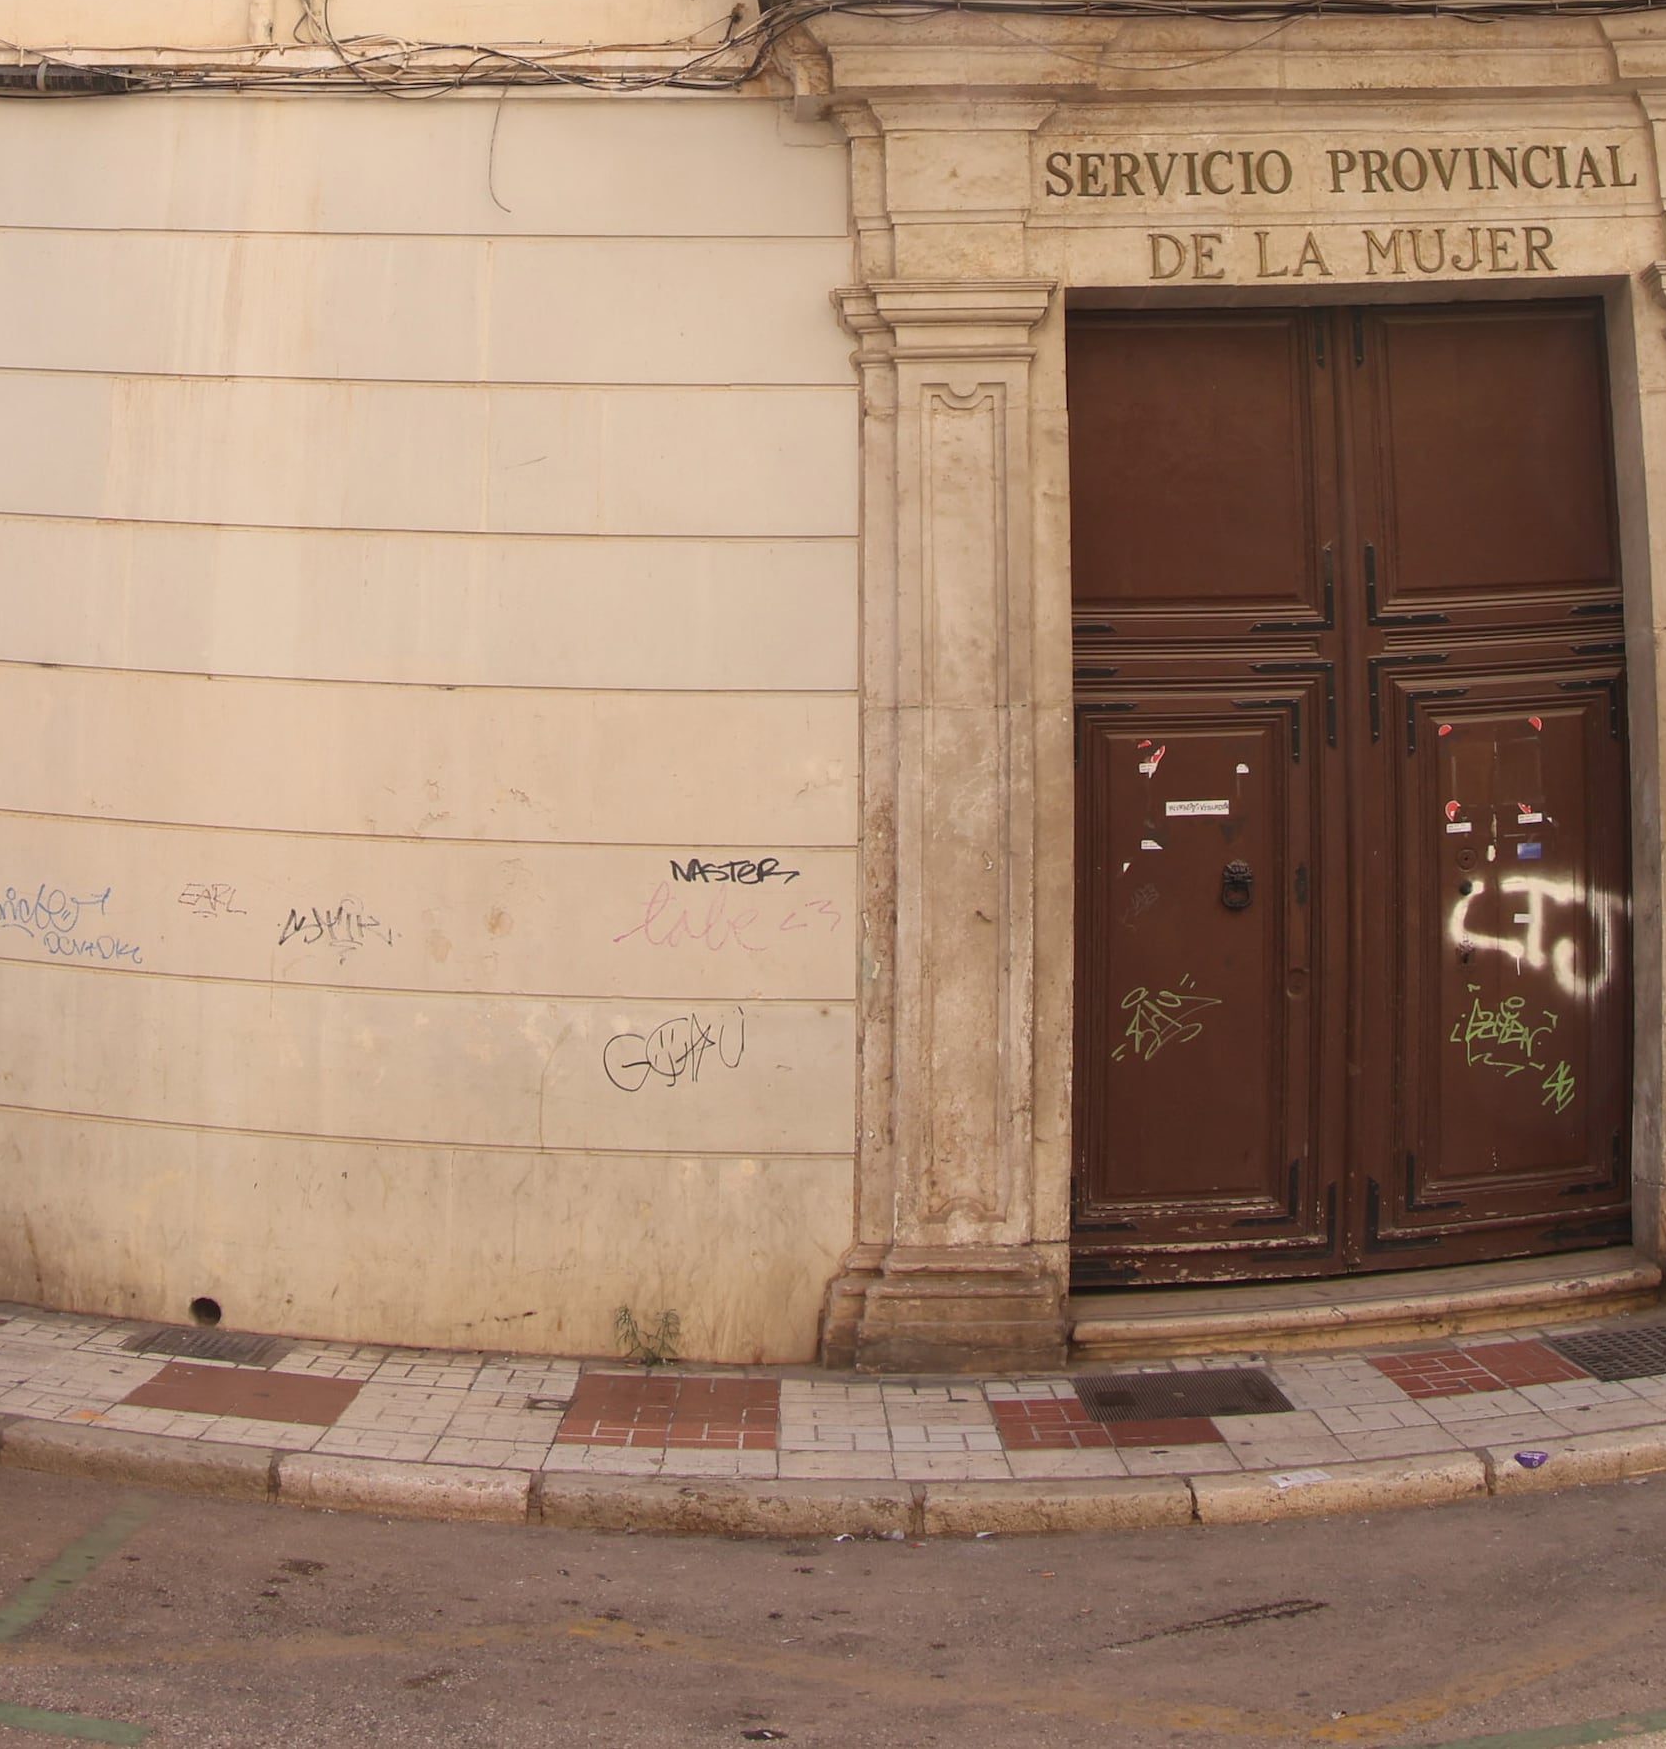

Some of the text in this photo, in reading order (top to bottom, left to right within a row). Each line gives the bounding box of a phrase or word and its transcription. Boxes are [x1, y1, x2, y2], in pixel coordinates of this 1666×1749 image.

[1045, 144, 1637, 197] SERVICIO PROVINCIAL
[1149, 226, 1557, 279] DE LA MUJER
